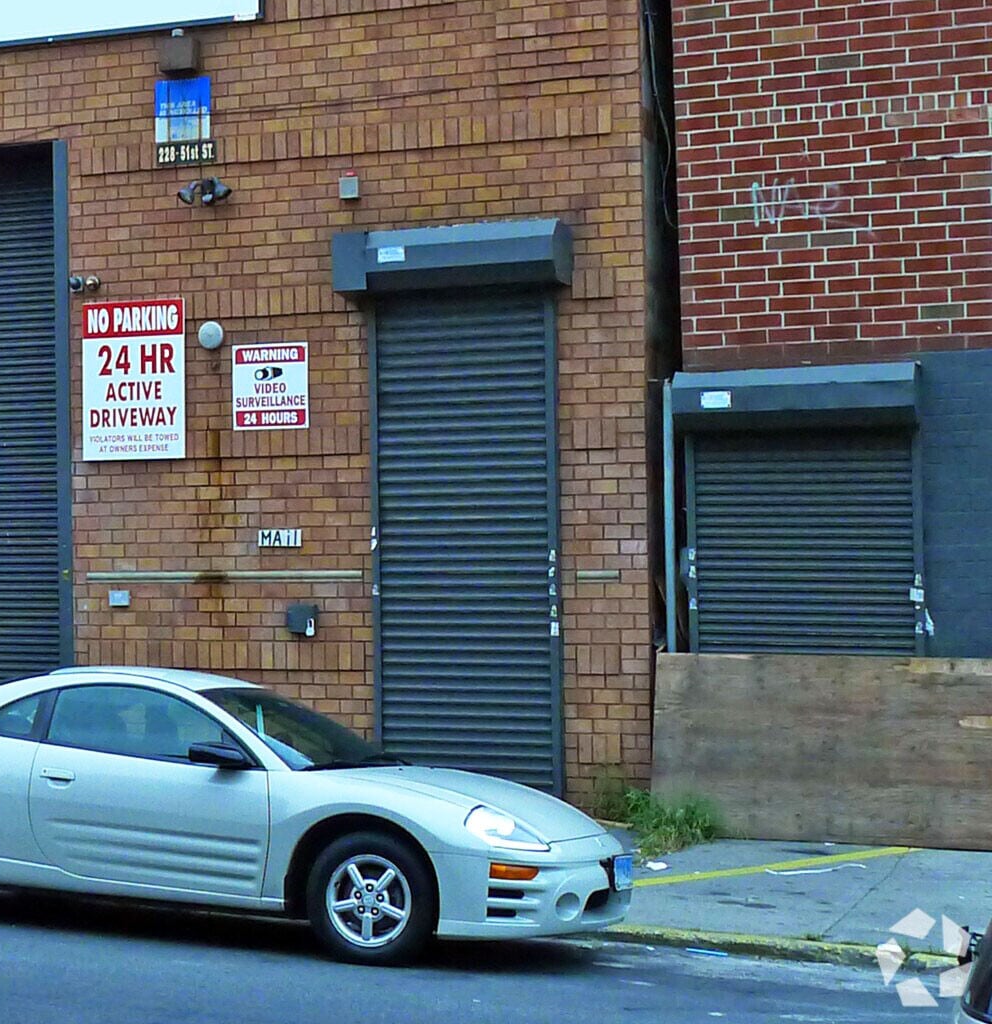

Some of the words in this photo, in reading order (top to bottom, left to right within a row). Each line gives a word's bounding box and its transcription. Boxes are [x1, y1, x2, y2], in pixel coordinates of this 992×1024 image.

[88, 308, 109, 334] NO
[113, 305, 178, 332] PARKING
[98, 345, 130, 376] 24
[140, 343, 175, 374] HR
[242, 349, 298, 361] WARNING
[105, 381, 162, 401] ACTIVE
[254, 383, 286, 394] VIDEO
[236, 395, 305, 407] SURVEILLANCE
[90, 407, 177, 428] DRIVEWAY
[244, 413, 256, 424] 24
[262, 412, 297, 424] HOURS
[90, 435, 125, 443] VIOLATORS
[155, 433, 179, 441] TOWED
[99, 445, 107, 453] AT
[109, 444, 137, 453] OWNERS
[139, 443, 169, 452] EXPENSE
